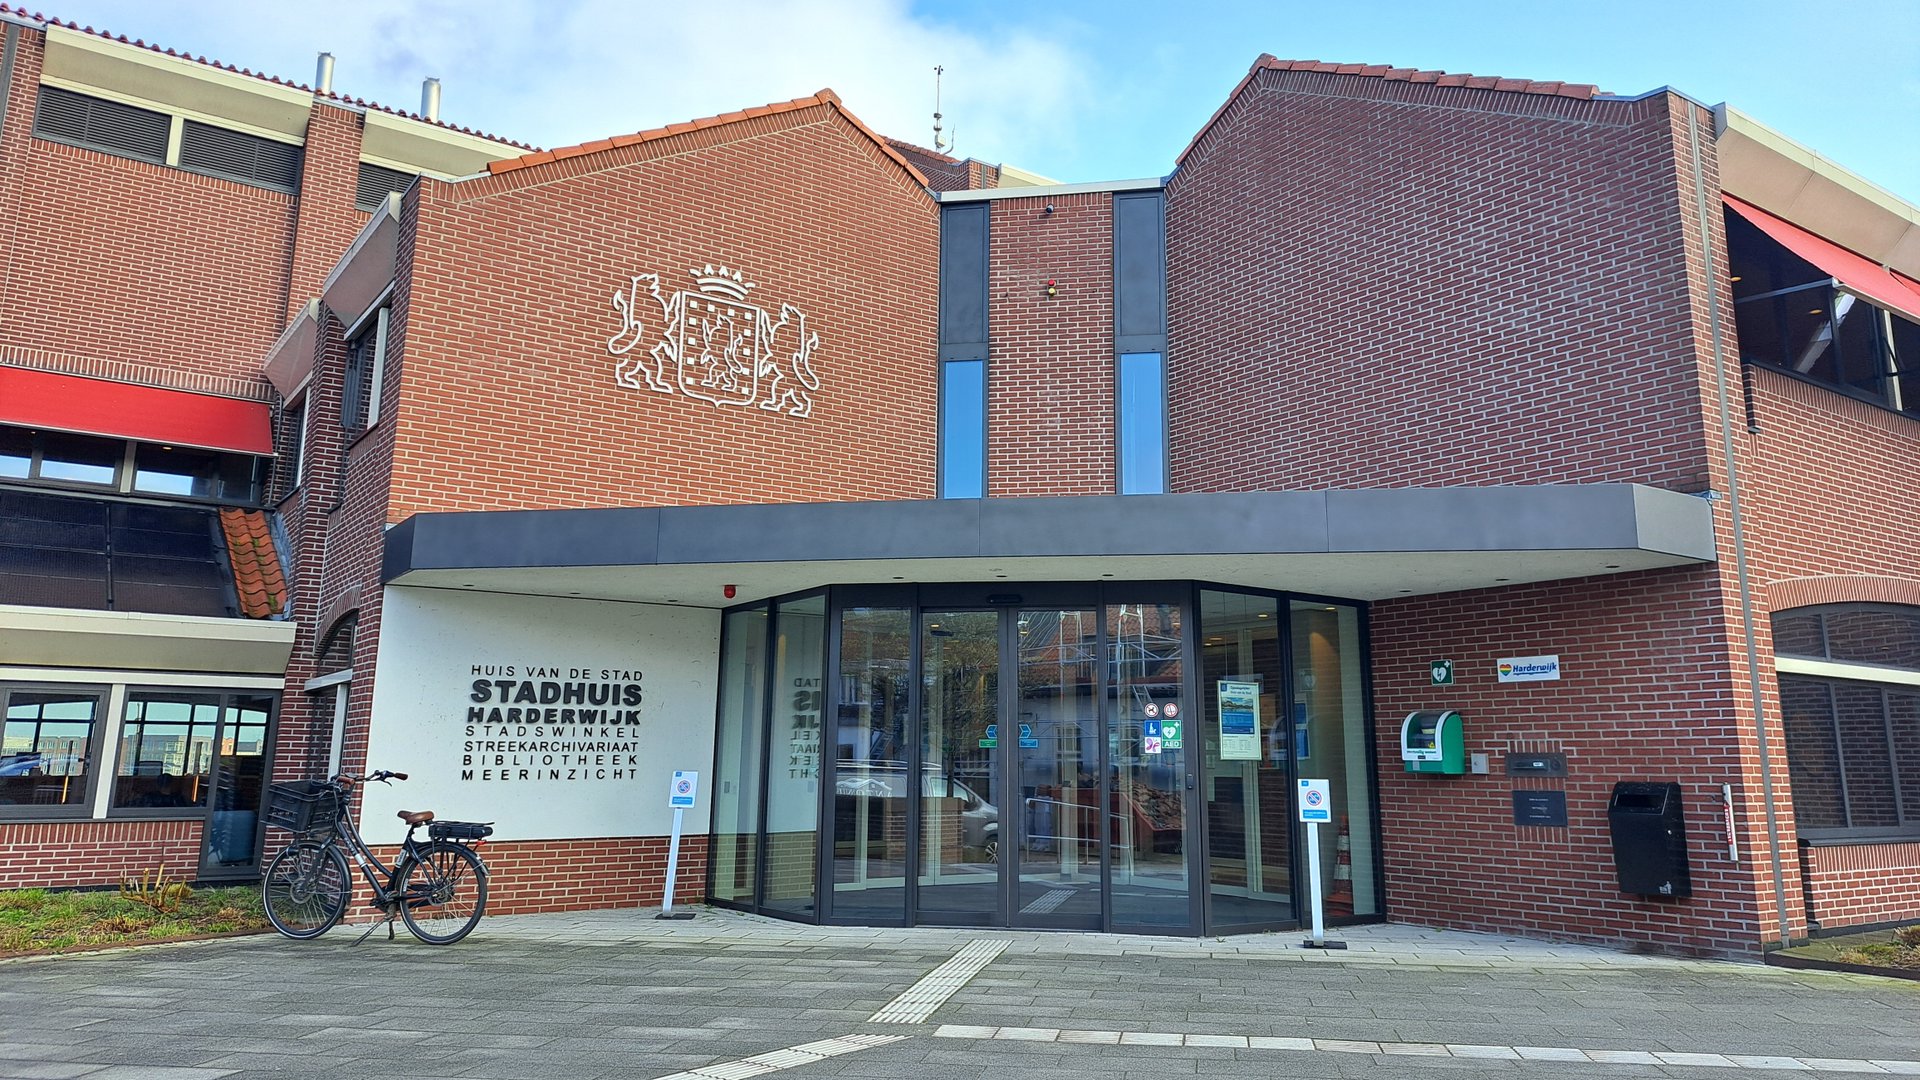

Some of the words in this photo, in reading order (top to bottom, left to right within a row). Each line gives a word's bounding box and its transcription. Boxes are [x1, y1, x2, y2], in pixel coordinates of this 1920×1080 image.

[472, 665, 515, 676] HUIS
[526, 667, 559, 678] VAN
[569, 668, 591, 680] DE
[601, 669, 643, 681] STAD
[1513, 662, 1557, 673] Harderwijk
[470, 679, 642, 706] STADHUIS
[467, 707, 642, 725] HARDERWIJK
[465, 725, 639, 738] STADSWINKEL
[464, 741, 639, 752] STREEKARCHIVARIAAT
[463, 754, 638, 766] BIBLIOTHEEK
[461, 769, 637, 781] MEERINZICHT
